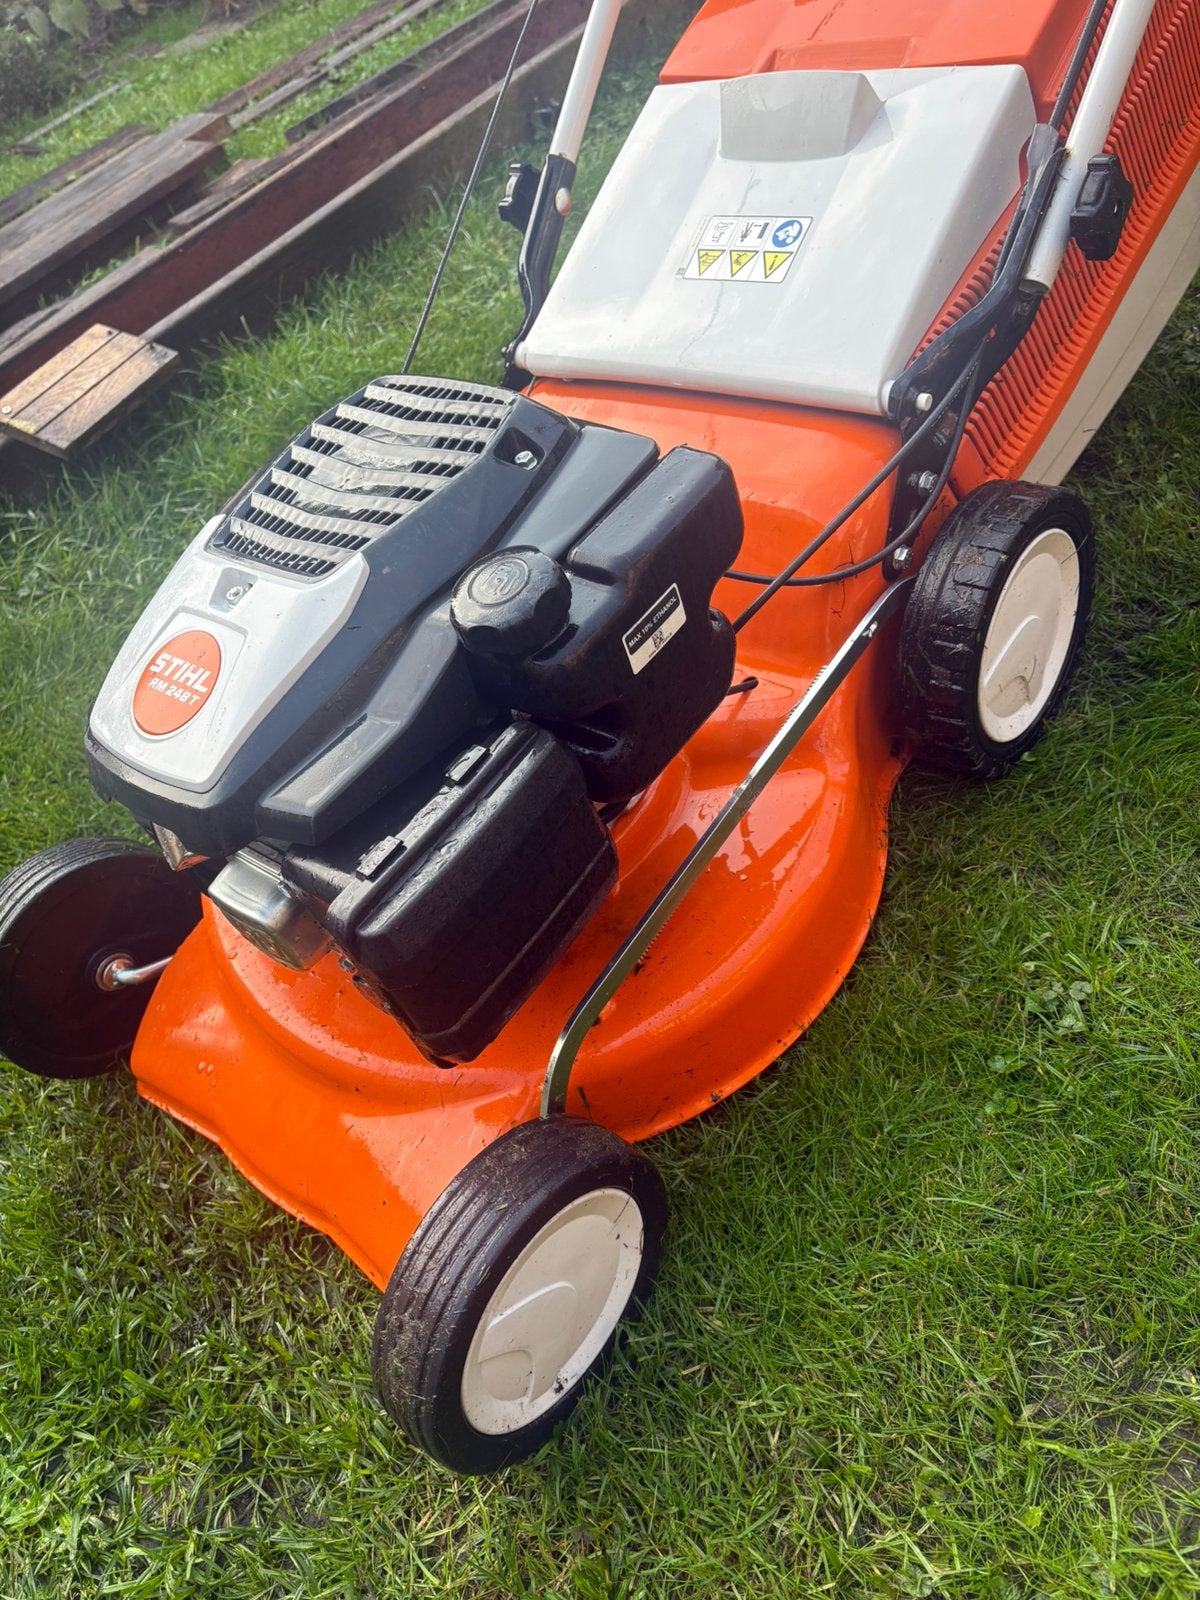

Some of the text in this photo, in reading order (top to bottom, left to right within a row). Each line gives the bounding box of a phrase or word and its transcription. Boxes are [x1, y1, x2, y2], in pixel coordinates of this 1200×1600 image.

[628, 632, 641, 648] MAX
[642, 621, 653, 634] 10%
[653, 597, 677, 623] ETHANOL
[148, 677, 168, 692] RM
[188, 694, 200, 705] T
[149, 652, 211, 693] STIHL
